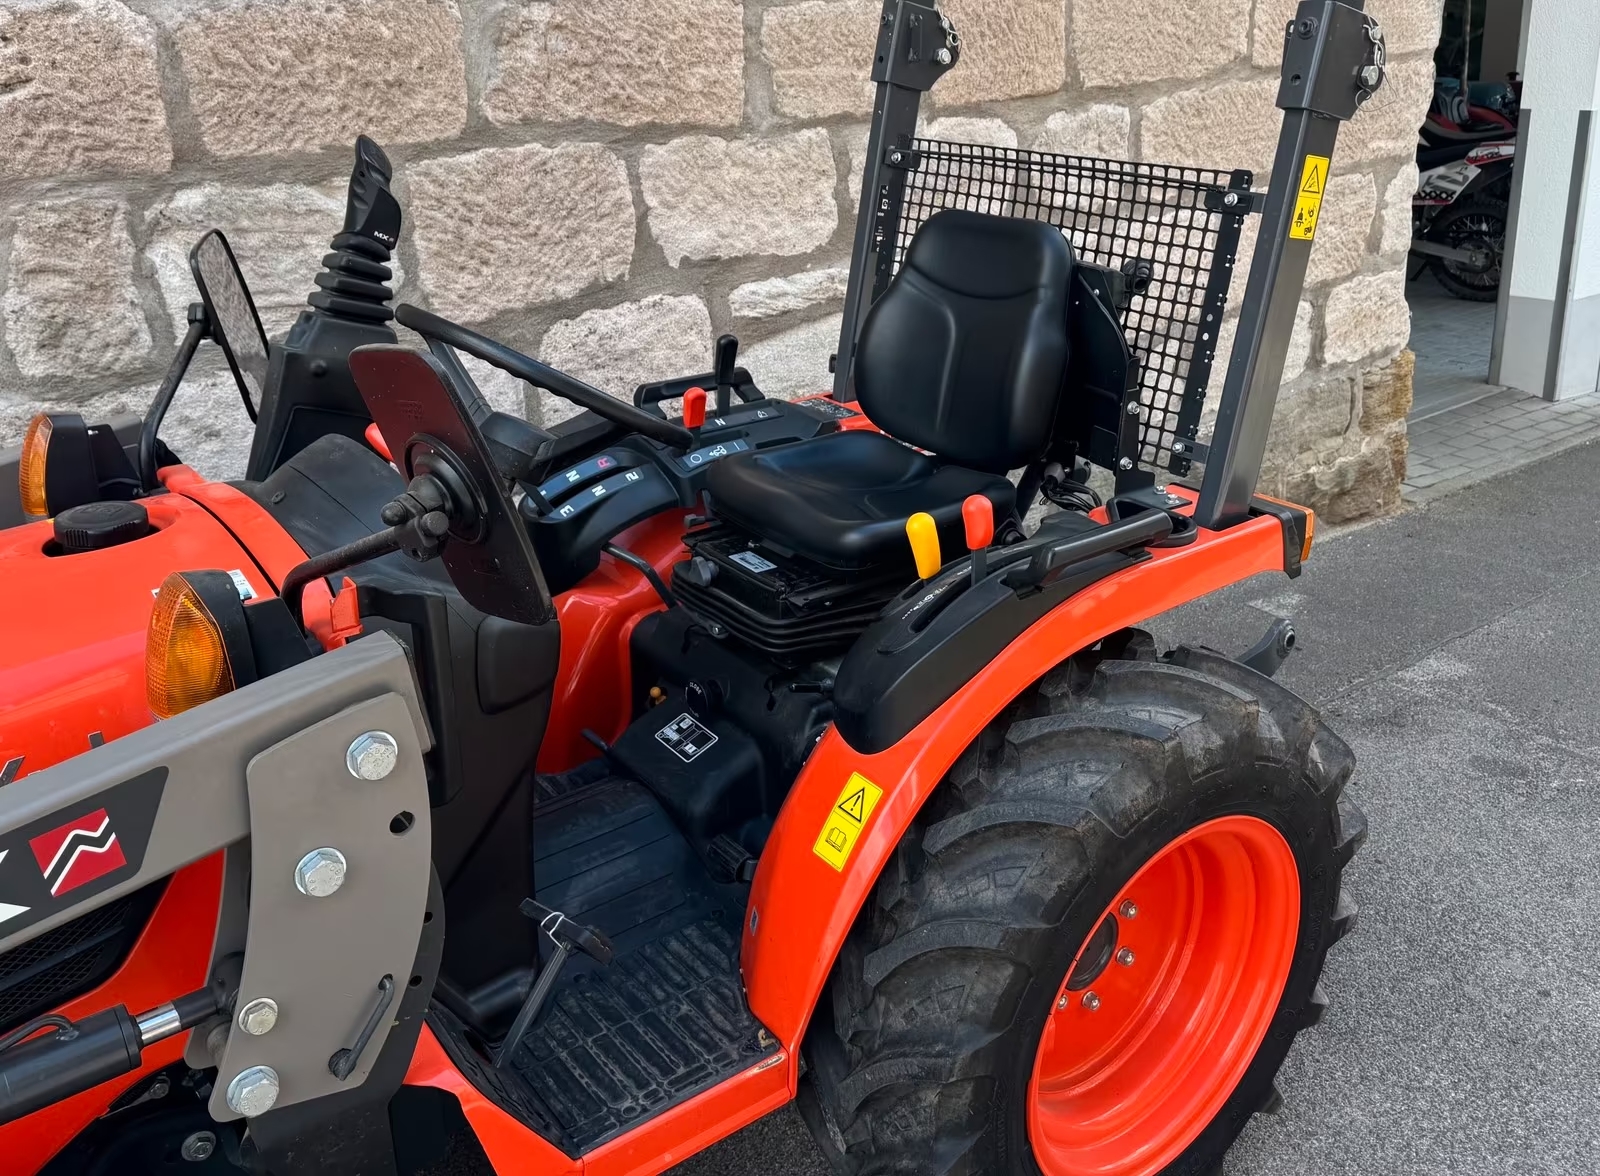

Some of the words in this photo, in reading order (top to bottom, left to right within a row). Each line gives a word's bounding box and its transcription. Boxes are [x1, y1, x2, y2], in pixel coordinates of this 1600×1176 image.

[374, 231, 389, 240] MX
[715, 418, 726, 426] N
[597, 458, 610, 469] R
[566, 470, 580, 482] N
[625, 471, 639, 482] 2
[591, 485, 607, 497] N
